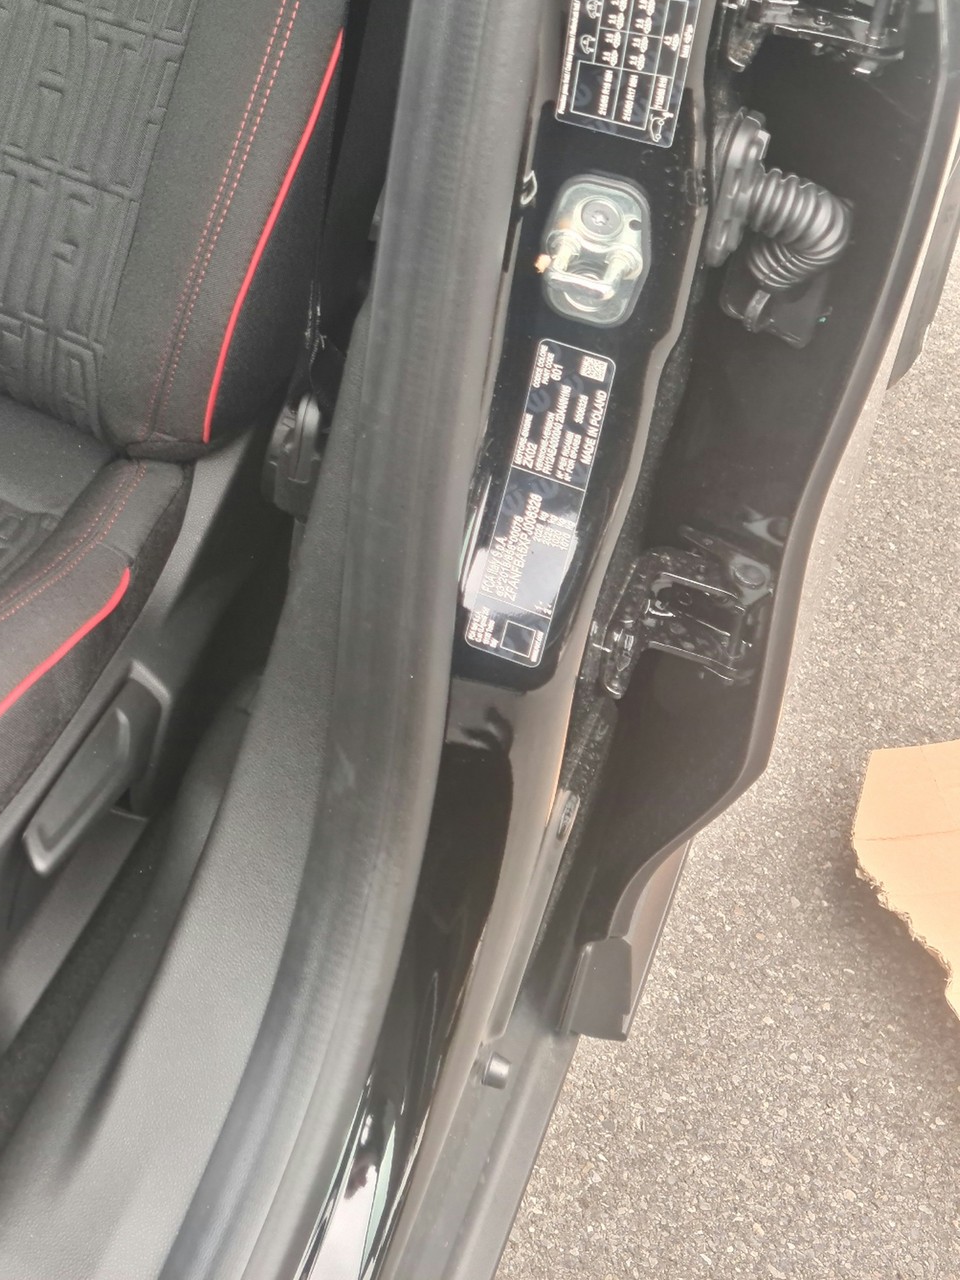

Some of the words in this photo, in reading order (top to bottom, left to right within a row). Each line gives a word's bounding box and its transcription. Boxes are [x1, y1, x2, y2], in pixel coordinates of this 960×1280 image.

[549, 362, 564, 382] 601
[587, 387, 608, 427] POLAND
[585, 425, 598, 438] IN
[521, 441, 537, 469] ZK02
[578, 435, 596, 465] MADE
